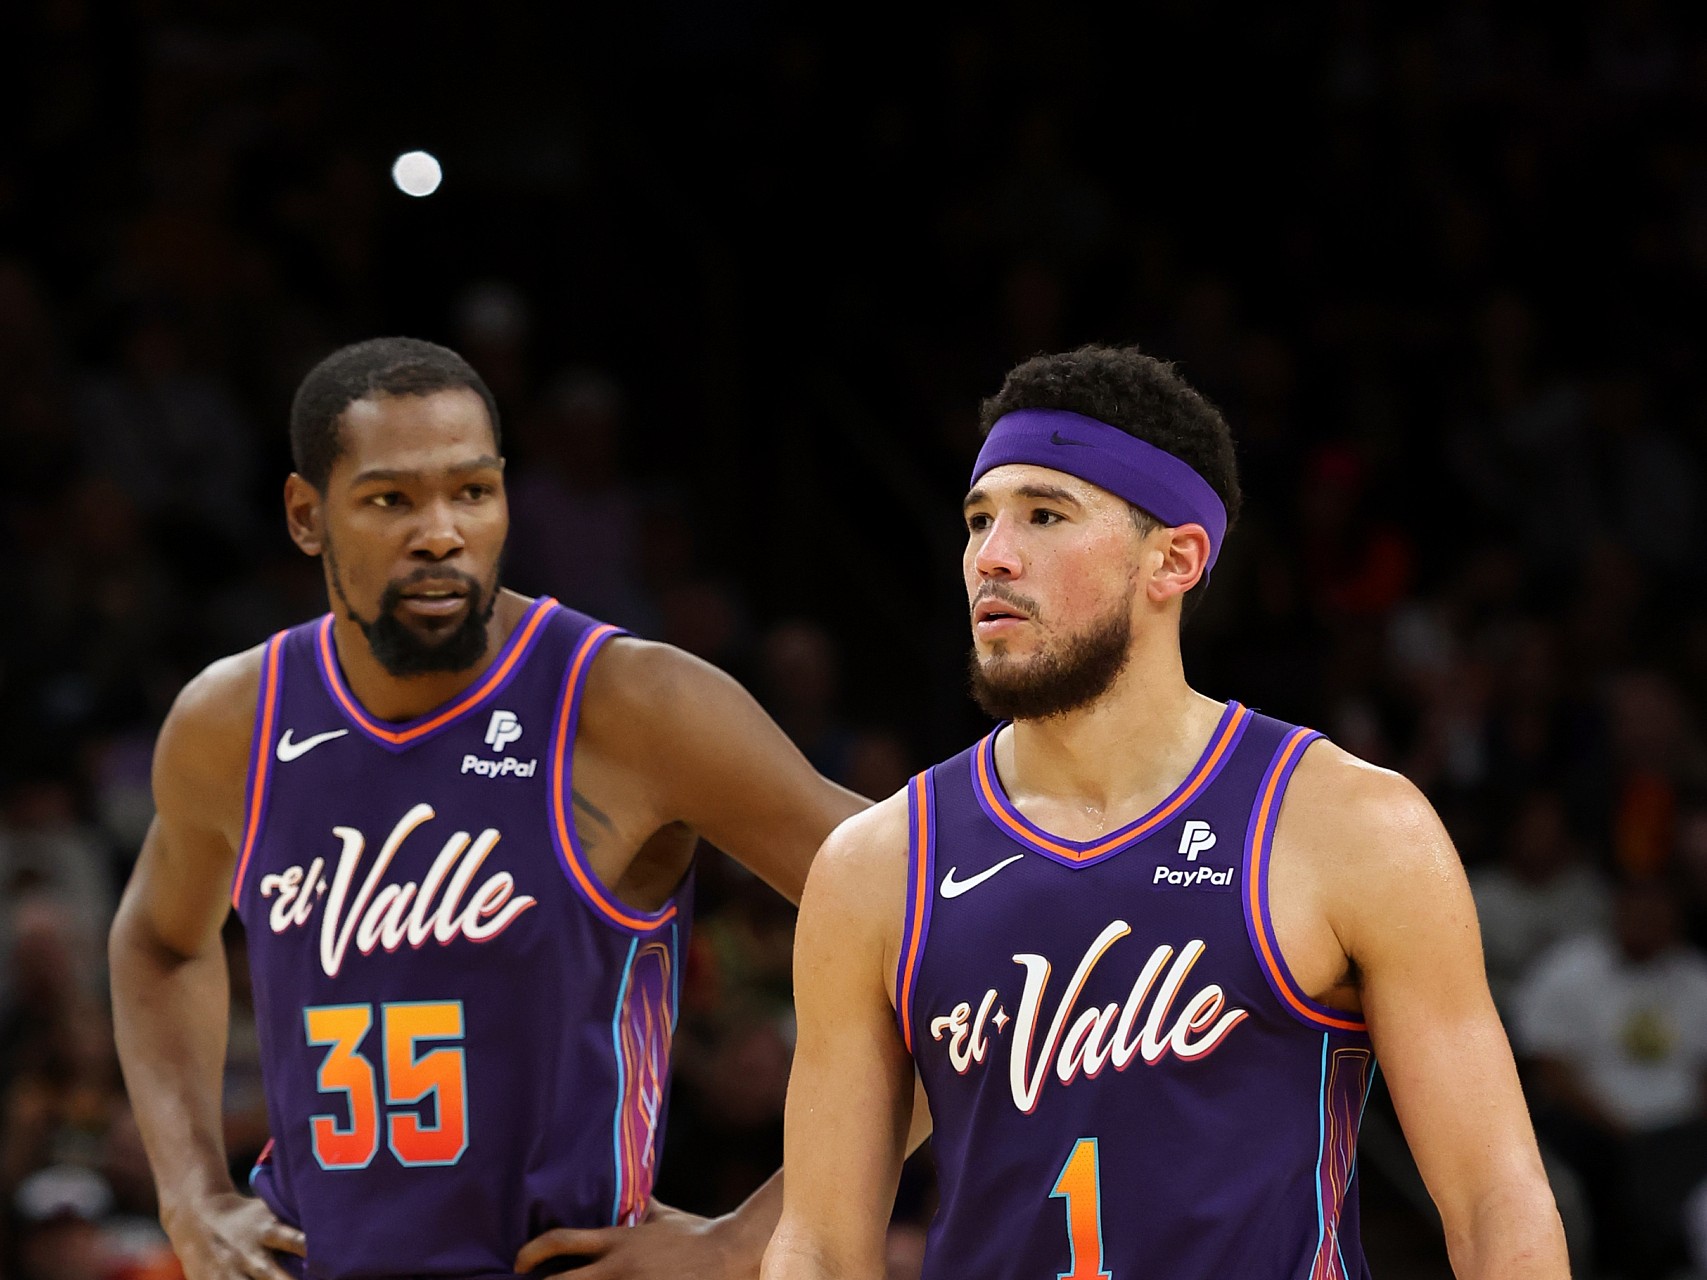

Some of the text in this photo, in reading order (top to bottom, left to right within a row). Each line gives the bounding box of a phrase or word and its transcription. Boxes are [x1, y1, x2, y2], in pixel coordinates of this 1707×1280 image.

[460, 754, 538, 778] PayPal
[319, 803, 537, 977] Valle
[1153, 866, 1234, 887] PayPal
[303, 1000, 469, 1170] 35
[1009, 920, 1249, 1115] Valle
